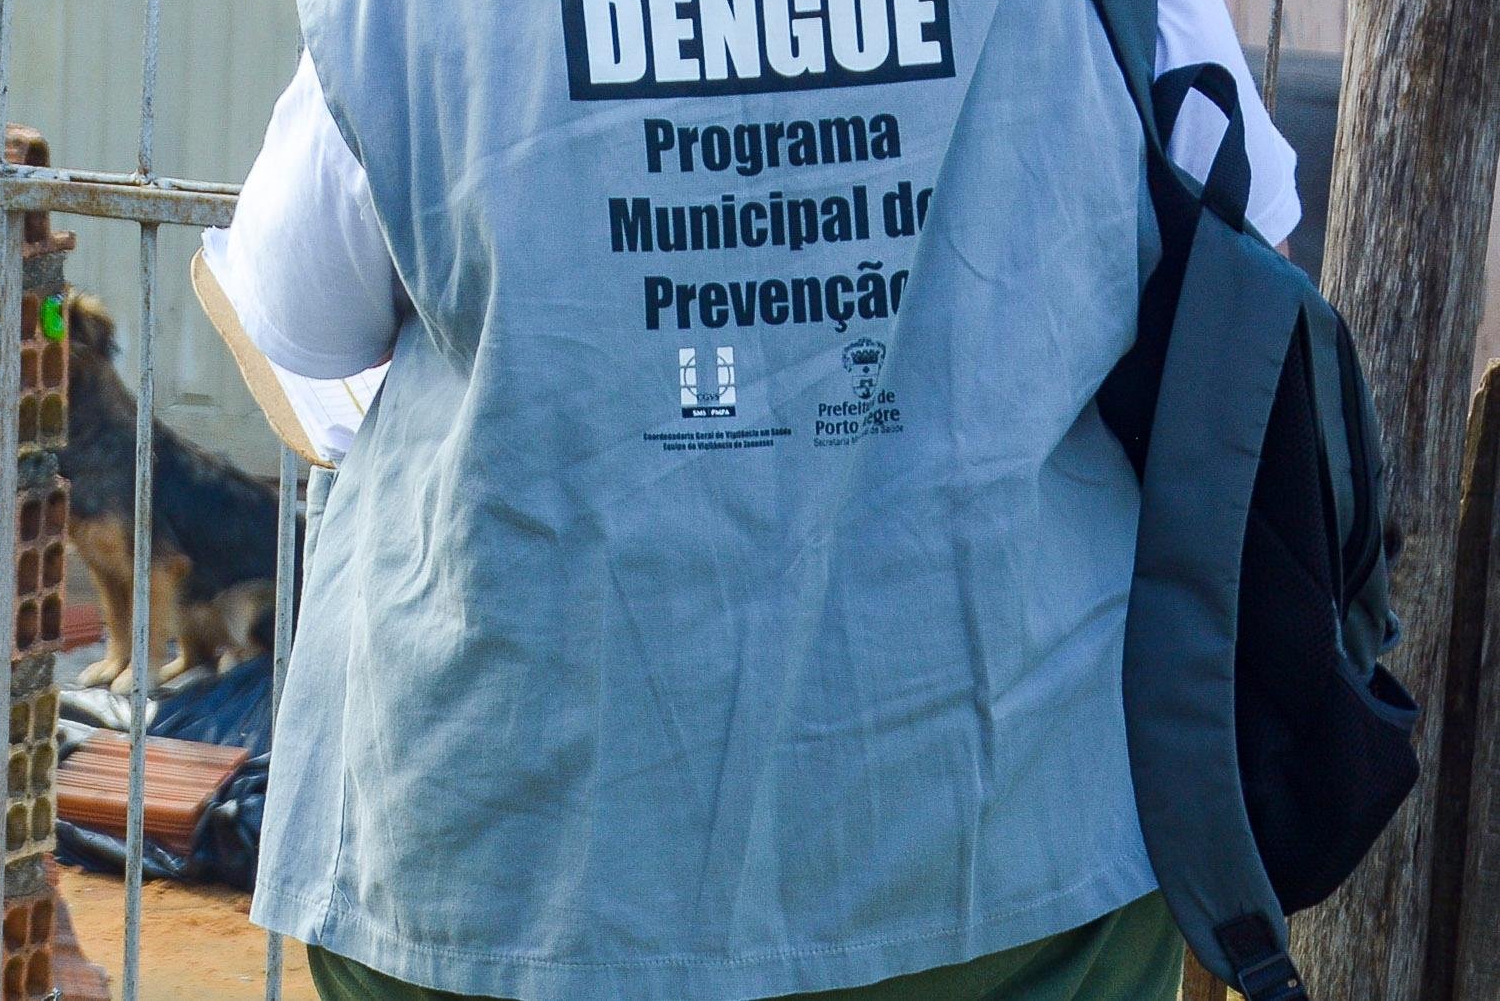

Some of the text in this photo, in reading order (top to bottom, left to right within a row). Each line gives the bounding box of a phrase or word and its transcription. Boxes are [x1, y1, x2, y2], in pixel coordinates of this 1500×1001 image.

[644, 114, 901, 177] Programa
[608, 185, 870, 253] Municipal
[877, 389, 896, 404] de
[815, 419, 859, 436] Porto
